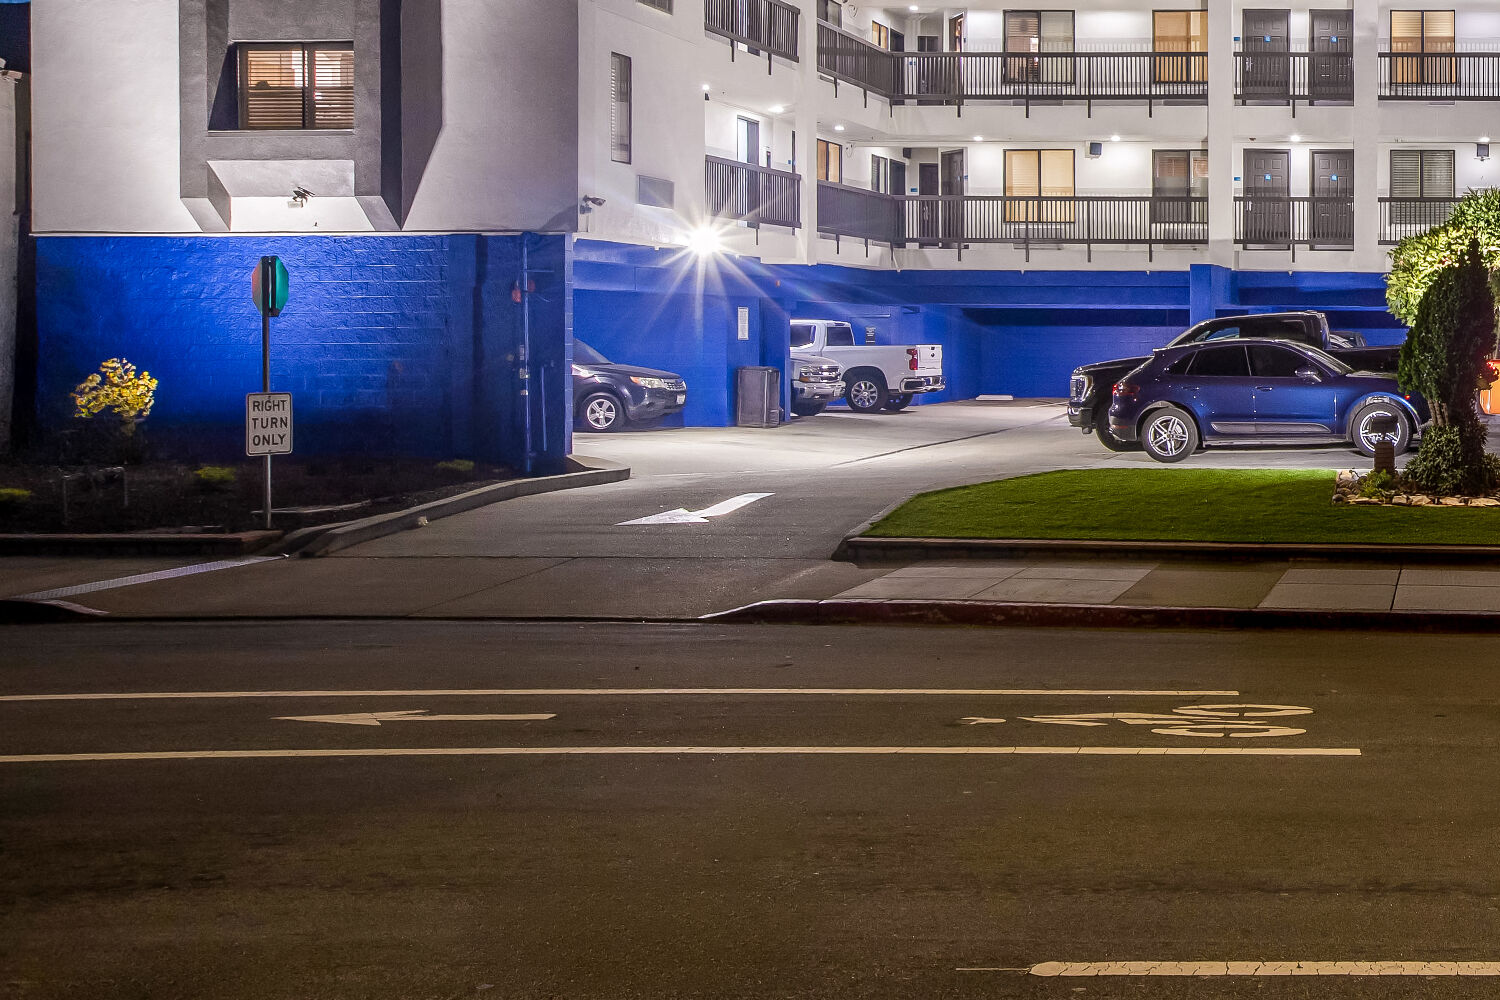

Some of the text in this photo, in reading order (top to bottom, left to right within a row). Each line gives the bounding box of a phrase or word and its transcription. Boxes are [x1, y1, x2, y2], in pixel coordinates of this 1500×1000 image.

[252, 400, 287, 412] RIGHT
[251, 417, 288, 430] TURN
[252, 434, 287, 446] ONLY
